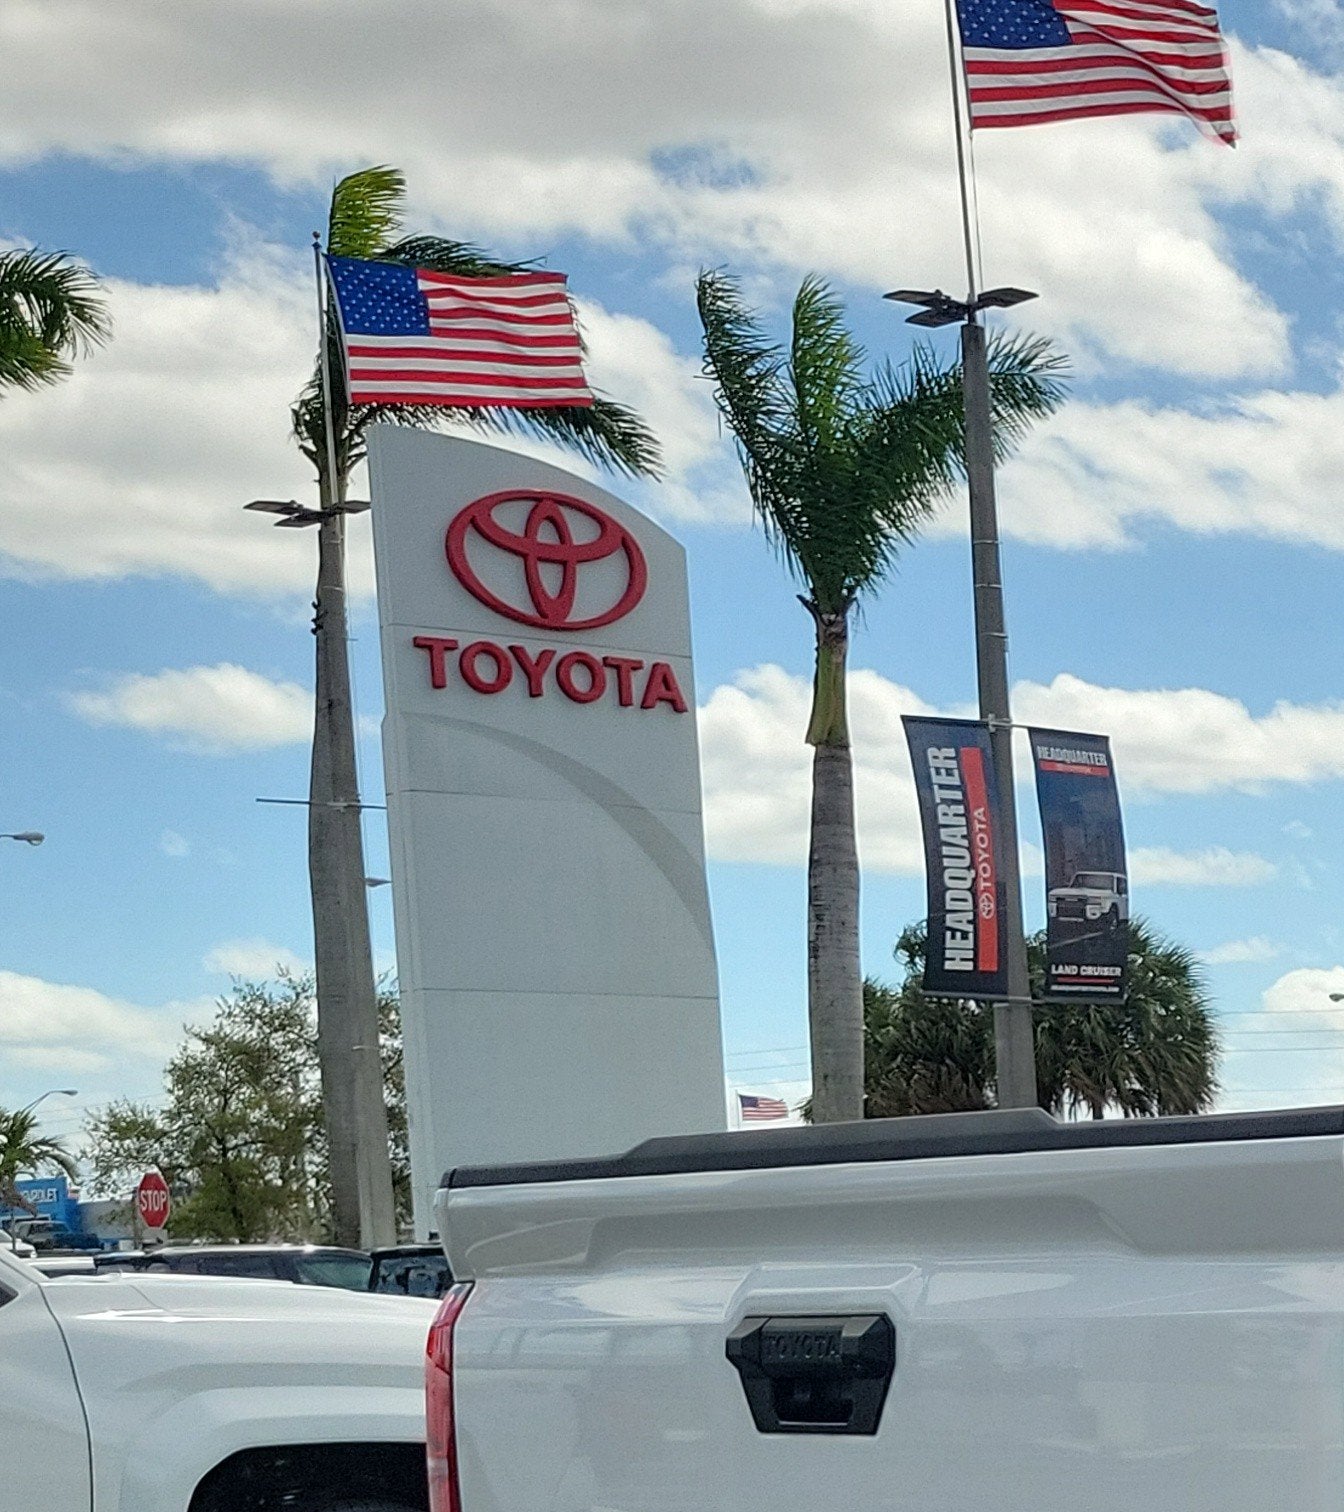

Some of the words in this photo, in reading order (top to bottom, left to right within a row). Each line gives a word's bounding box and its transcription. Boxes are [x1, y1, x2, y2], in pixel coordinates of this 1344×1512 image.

[413, 635, 688, 713] TOYOTA
[927, 746, 975, 971] HEADQUARTER
[973, 807, 992, 889] TOYOTA
[1051, 964, 1078, 975] LAND
[140, 1189, 167, 1211] STOP
[766, 1333, 842, 1359] TOYOTA
